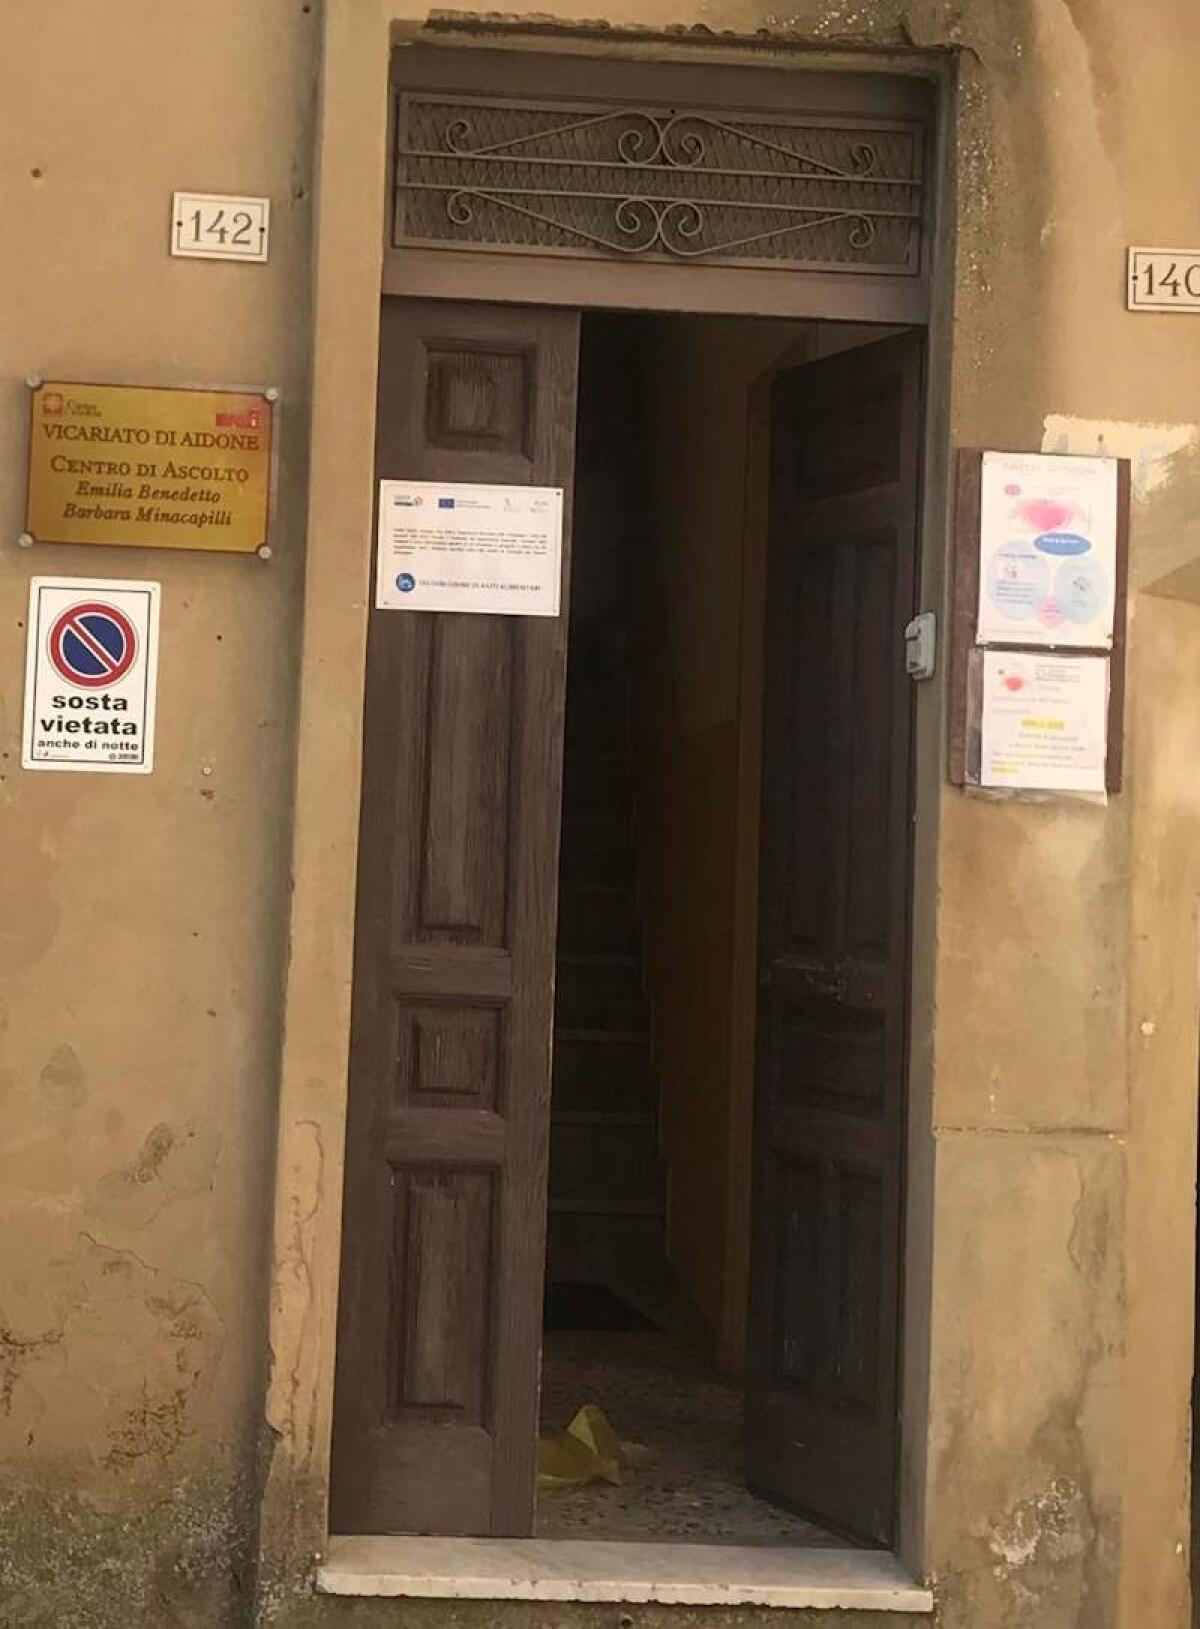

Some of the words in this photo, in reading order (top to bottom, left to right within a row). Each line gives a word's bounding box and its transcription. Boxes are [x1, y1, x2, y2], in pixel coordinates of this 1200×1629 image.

[191, 210, 252, 245] 142
[42, 424, 150, 444] VICARIATO
[155, 431, 175, 445] DI
[180, 432, 259, 450] AIDONE
[76, 481, 132, 499] Emilia
[138, 485, 221, 504] Benedetto
[63, 503, 131, 521] Barbara
[136, 507, 232, 527] Minacapilli
[51, 693, 128, 711] sosta
[41, 715, 137, 735] vietata
[38, 739, 80, 749] anche
[85, 740, 97, 749] di
[101, 742, 138, 751] notte
